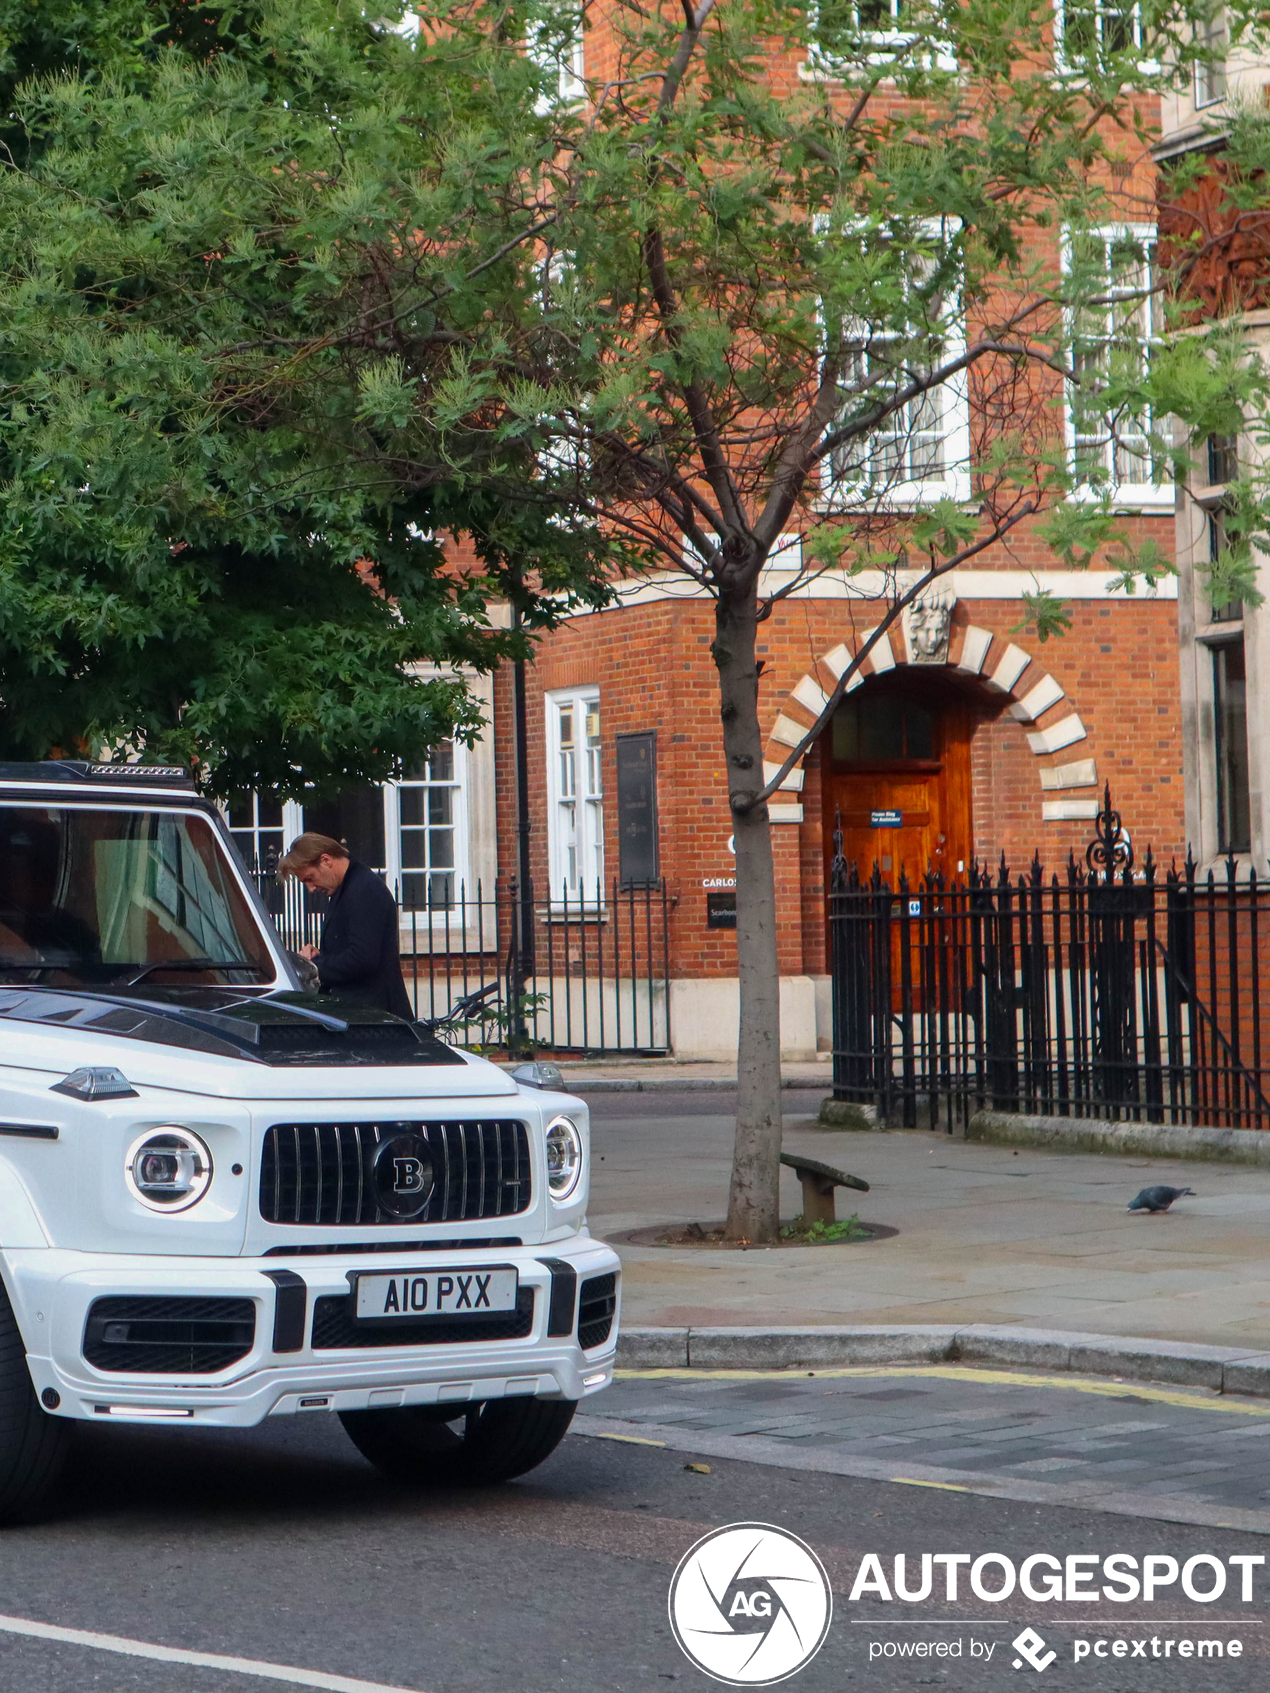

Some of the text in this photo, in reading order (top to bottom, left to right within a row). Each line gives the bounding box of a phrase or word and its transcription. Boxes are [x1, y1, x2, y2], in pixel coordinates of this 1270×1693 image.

[702, 878, 736, 888] CARLO
[393, 1157, 425, 1194] B
[437, 1274, 492, 1310] PXX
